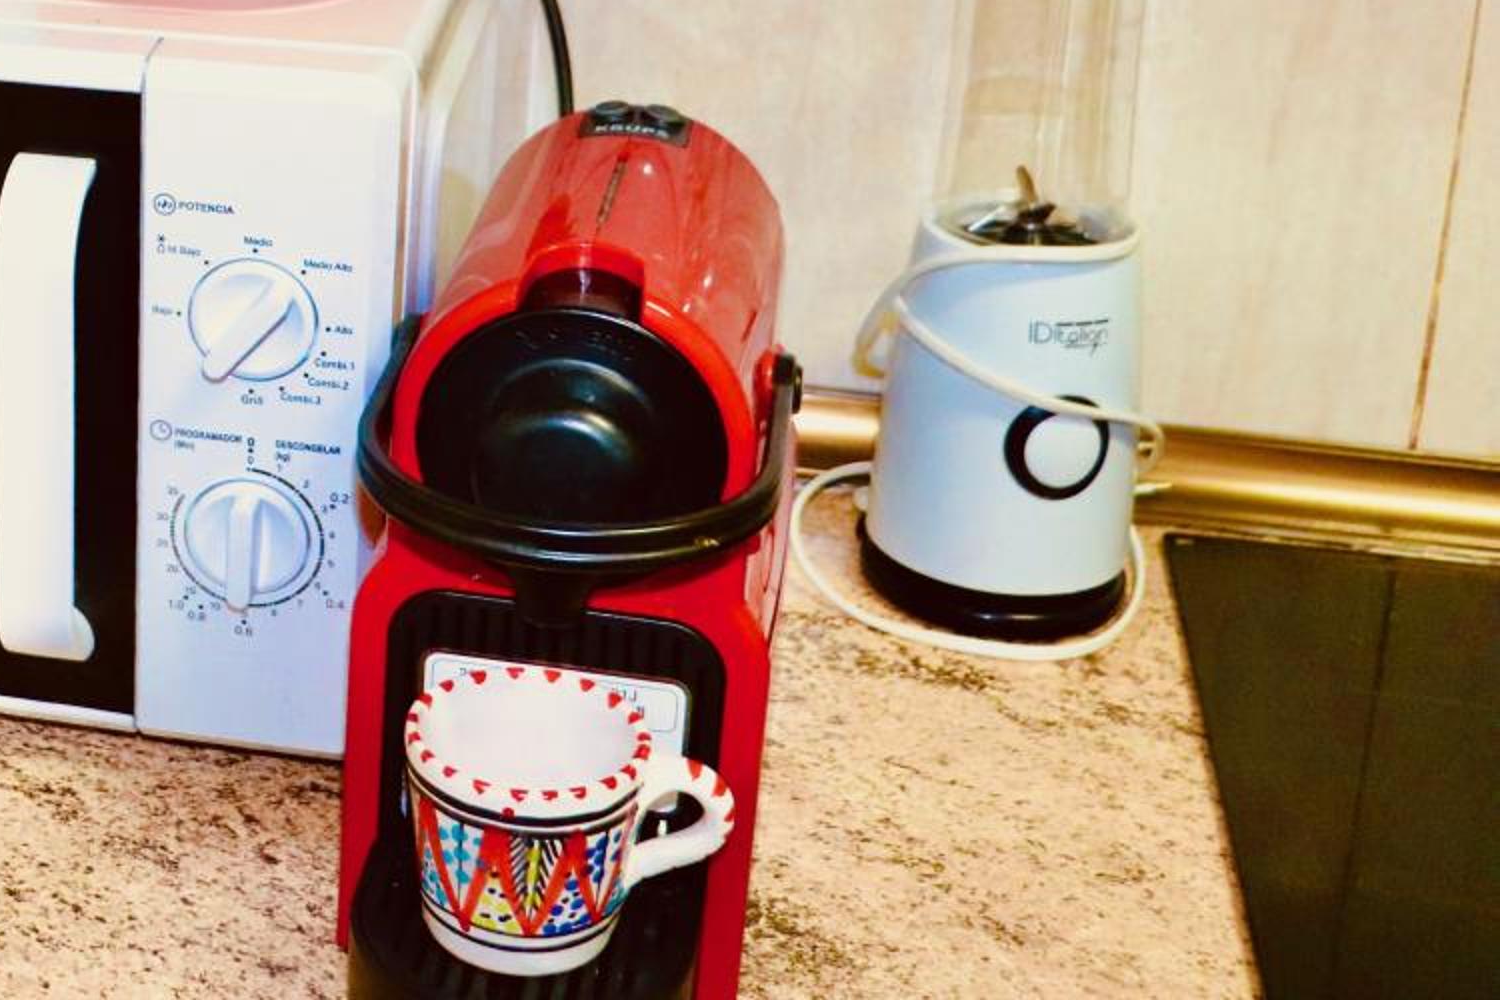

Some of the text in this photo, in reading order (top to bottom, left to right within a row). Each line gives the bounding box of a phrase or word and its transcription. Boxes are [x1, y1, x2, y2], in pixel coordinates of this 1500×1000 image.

[178, 201, 235, 214] POTENCIA
[175, 428, 242, 442] PROGRAMADOR
[276, 440, 341, 454] DESCONGELAR
